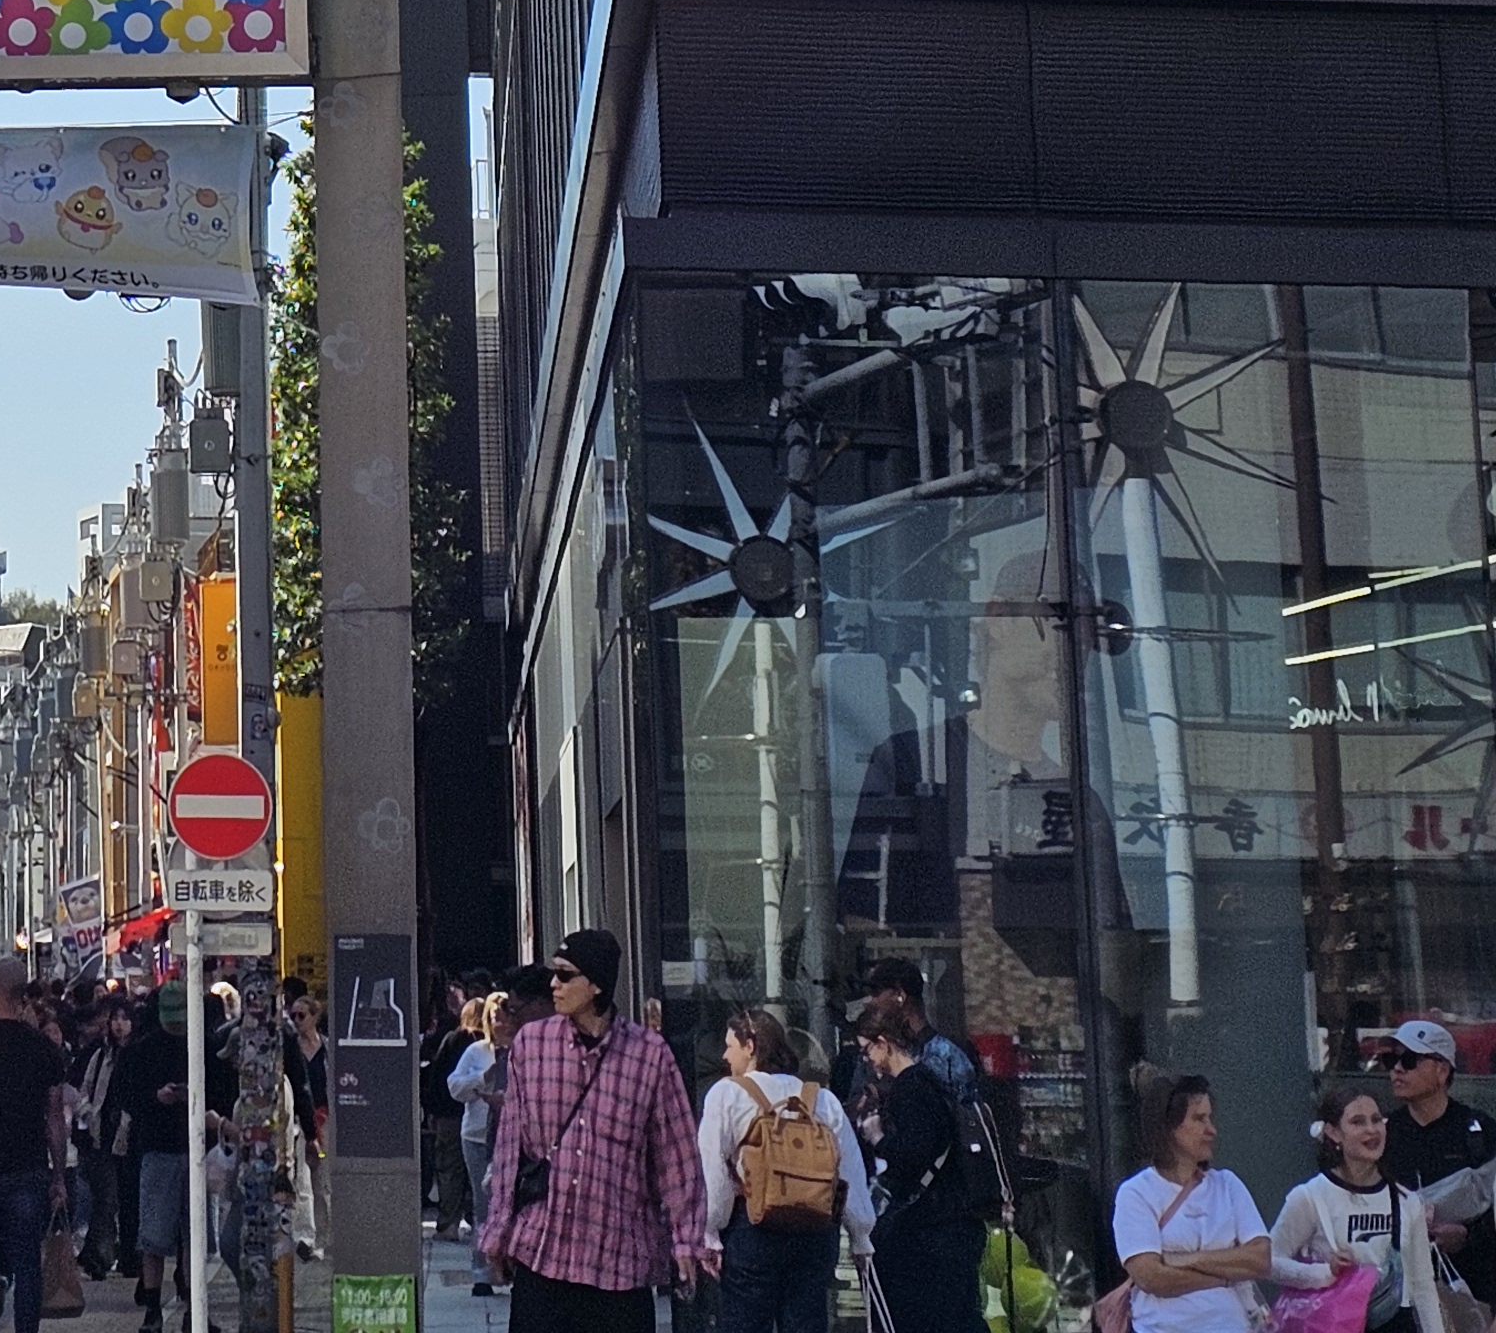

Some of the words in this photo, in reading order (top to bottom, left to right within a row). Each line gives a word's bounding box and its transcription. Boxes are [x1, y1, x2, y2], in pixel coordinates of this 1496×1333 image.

[174, 879, 266, 903] 自転車を除く
